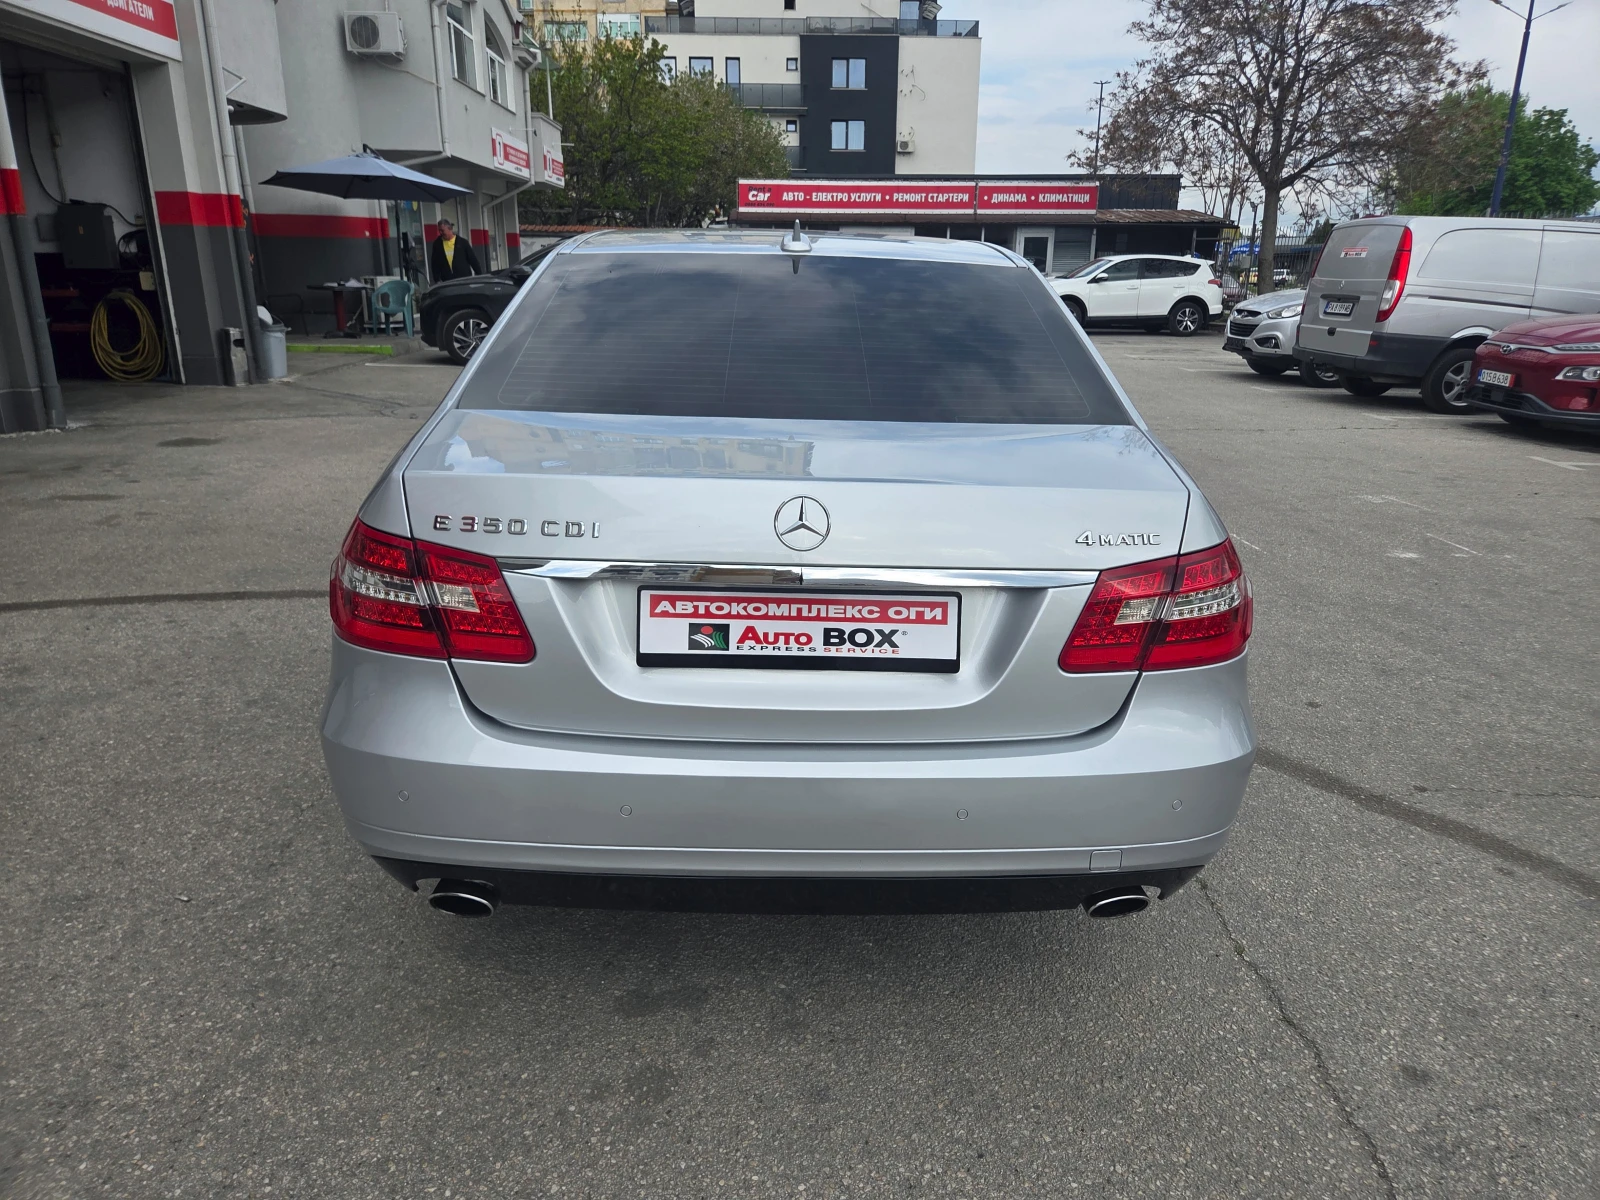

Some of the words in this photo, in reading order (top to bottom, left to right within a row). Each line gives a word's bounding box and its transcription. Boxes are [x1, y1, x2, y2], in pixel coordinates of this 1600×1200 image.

[748, 190, 771, 201] Car
[782, 192, 804, 201] АВТО
[812, 193, 848, 202] ЕЛЕКТРО
[850, 193, 881, 202] УСЛУГИ
[893, 193, 926, 202] РЕМОНТ
[928, 193, 969, 203] СТАРТЕРИ
[991, 193, 1027, 203] ДИНАМА
[1039, 193, 1090, 204] КЛИМАТИЦИ
[433, 515, 453, 531] E
[460, 516, 528, 535] 350
[541, 520, 600, 538] CDI
[1075, 530, 1161, 546] 4MATIC
[654, 600, 880, 619] АВТОКОМПЛЕКС
[888, 606, 942, 620] ОГИ
[736, 645, 817, 653] EXPRESS
[823, 647, 900, 655] SERVICE
